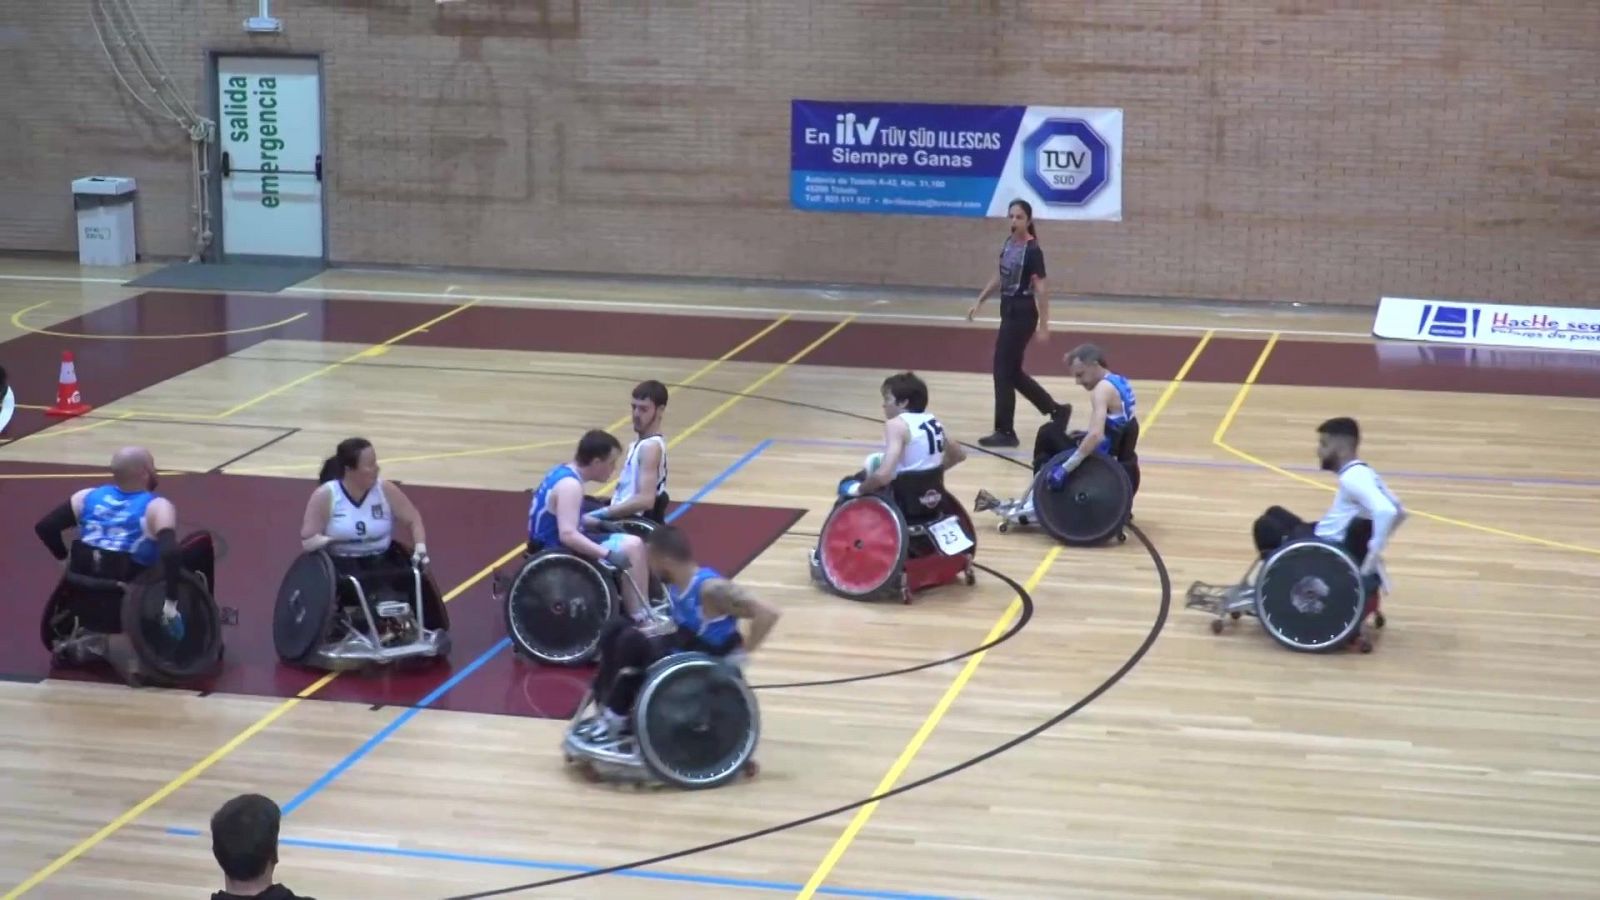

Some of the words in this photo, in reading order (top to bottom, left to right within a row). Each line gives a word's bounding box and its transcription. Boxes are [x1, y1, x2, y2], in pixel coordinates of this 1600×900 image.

[224, 76, 249, 143] salida
[253, 77, 285, 209] emergencia
[805, 128, 830, 144] En
[880, 127, 906, 147] TÜV
[909, 128, 936, 148] SÜD
[939, 131, 1001, 150] ILLESCAS
[832, 147, 908, 168] Siempre
[914, 150, 973, 167] Ganas
[355, 521, 367, 536] 9
